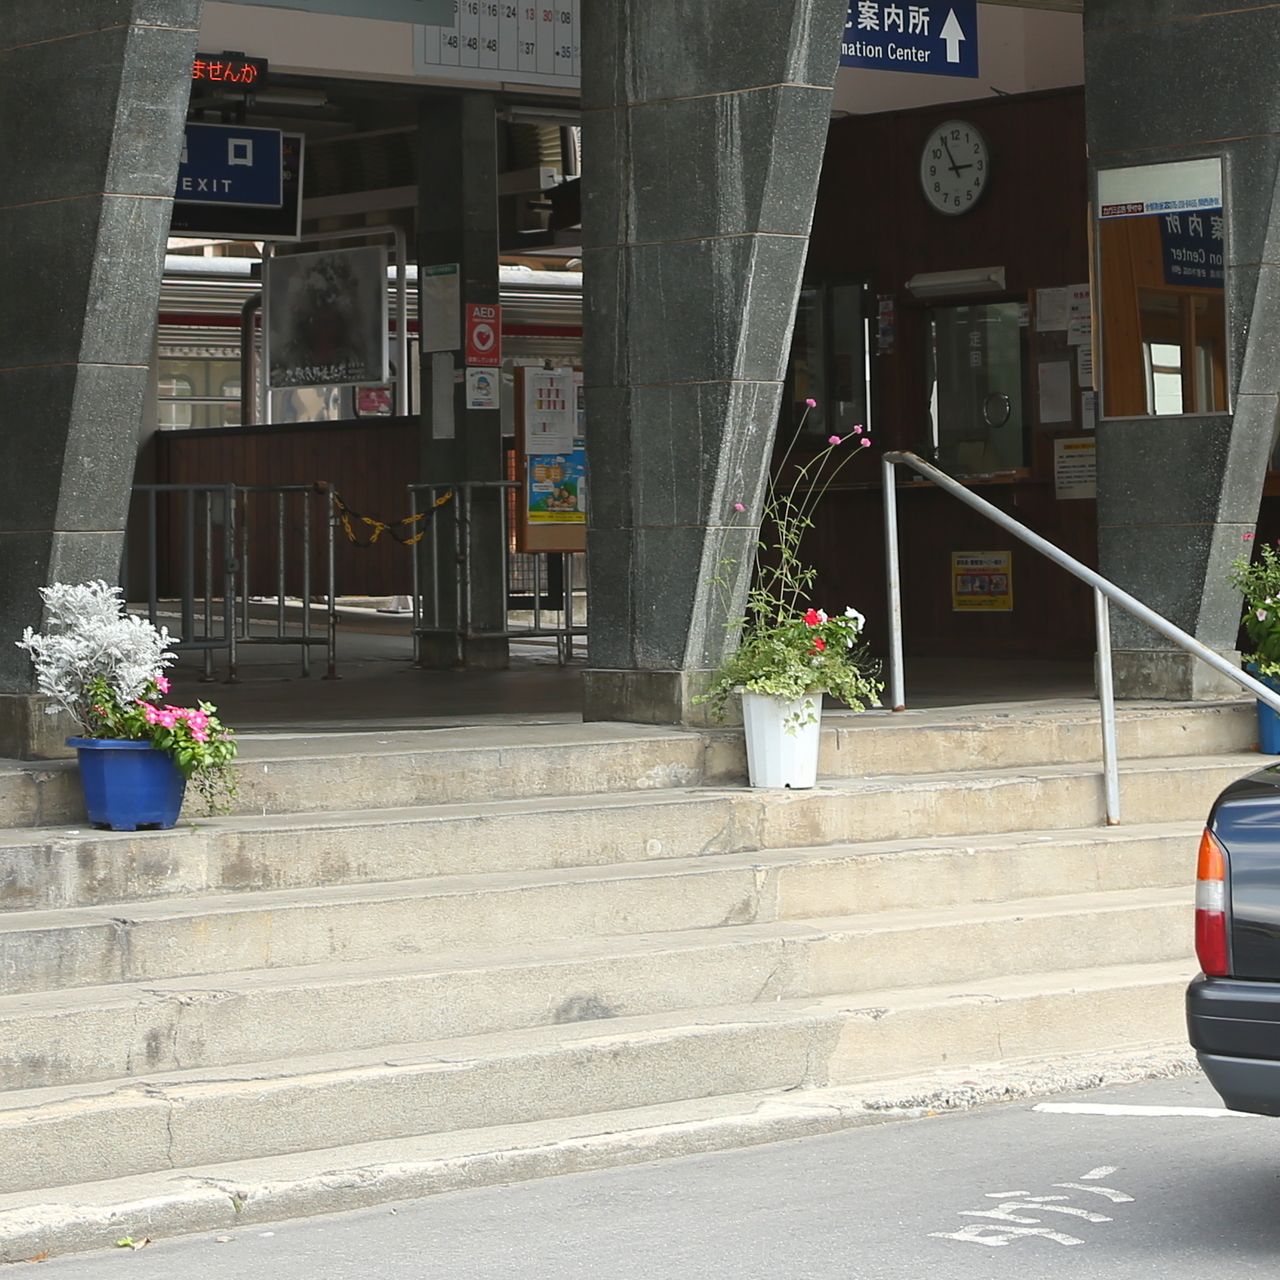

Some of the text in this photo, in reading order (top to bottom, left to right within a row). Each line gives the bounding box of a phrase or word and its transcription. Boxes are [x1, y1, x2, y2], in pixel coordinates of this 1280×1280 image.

[887, 42, 931, 63] Center
[950, 129, 960, 141] 12
[932, 148, 942, 160] 10
[973, 143, 980, 154] 2
[930, 165, 936, 176] 9
[977, 160, 983, 171] 3
[182, 177, 233, 193] EXIT
[934, 182, 940, 193] 8
[974, 177, 981, 188] 4
[943, 193, 949, 203] 7
[966, 190, 973, 201] 5
[954, 196, 960, 207] 6
[472, 306, 495, 318] AED
